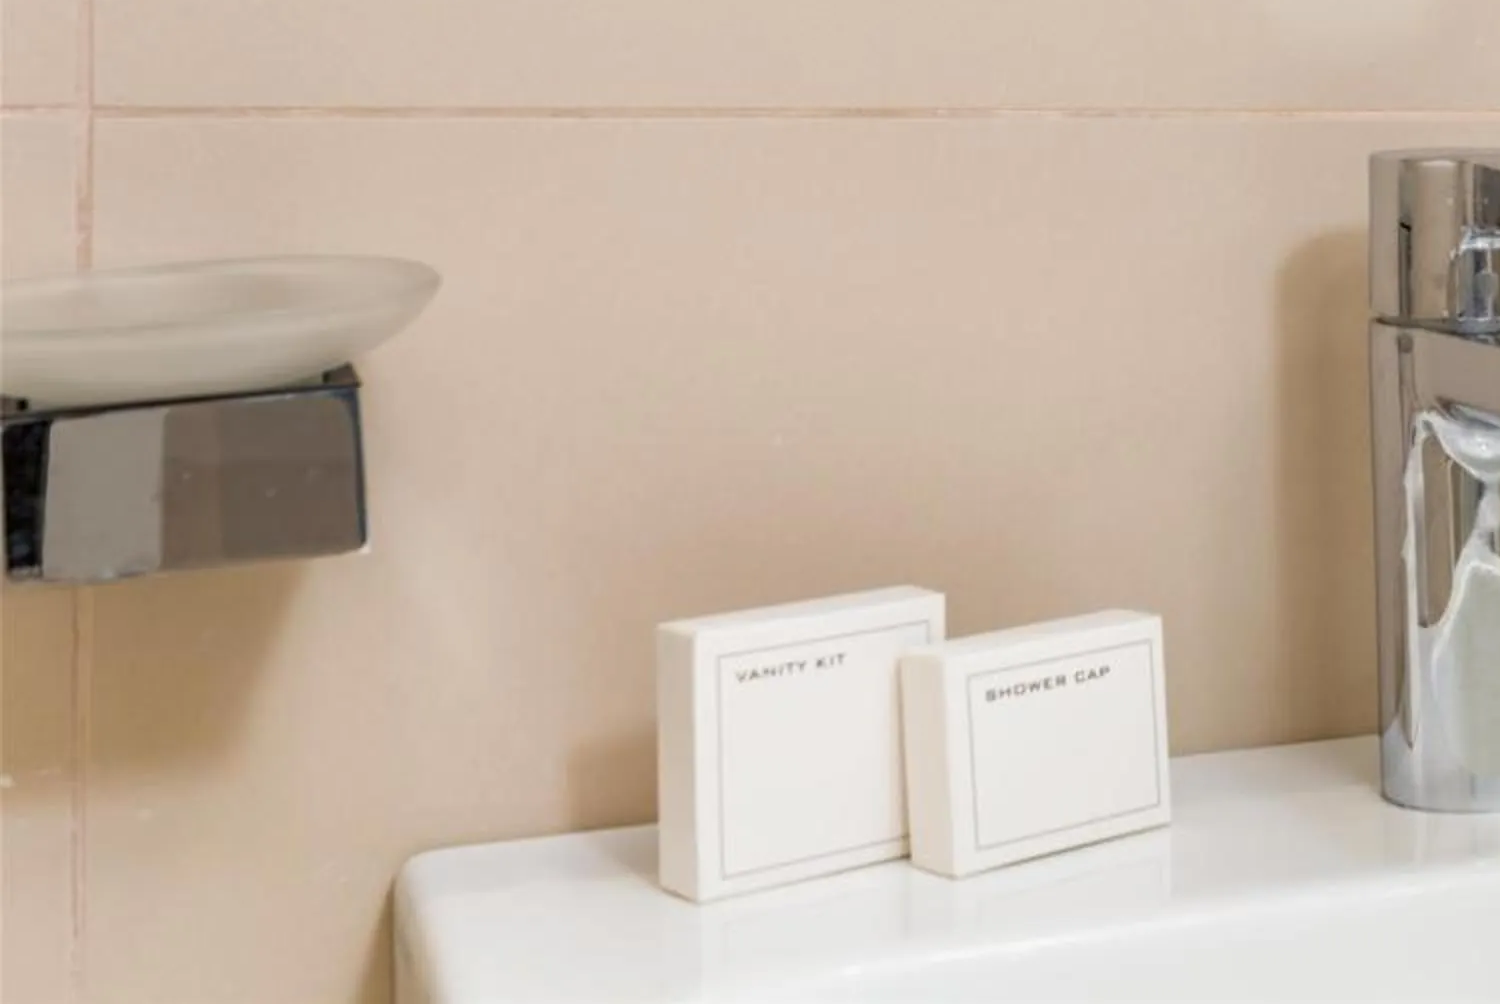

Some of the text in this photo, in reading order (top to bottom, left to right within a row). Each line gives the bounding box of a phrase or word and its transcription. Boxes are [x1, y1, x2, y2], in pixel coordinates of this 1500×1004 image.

[735, 652, 846, 683] VANITY KIT
[985, 665, 1110, 702] SHOWER CAP
